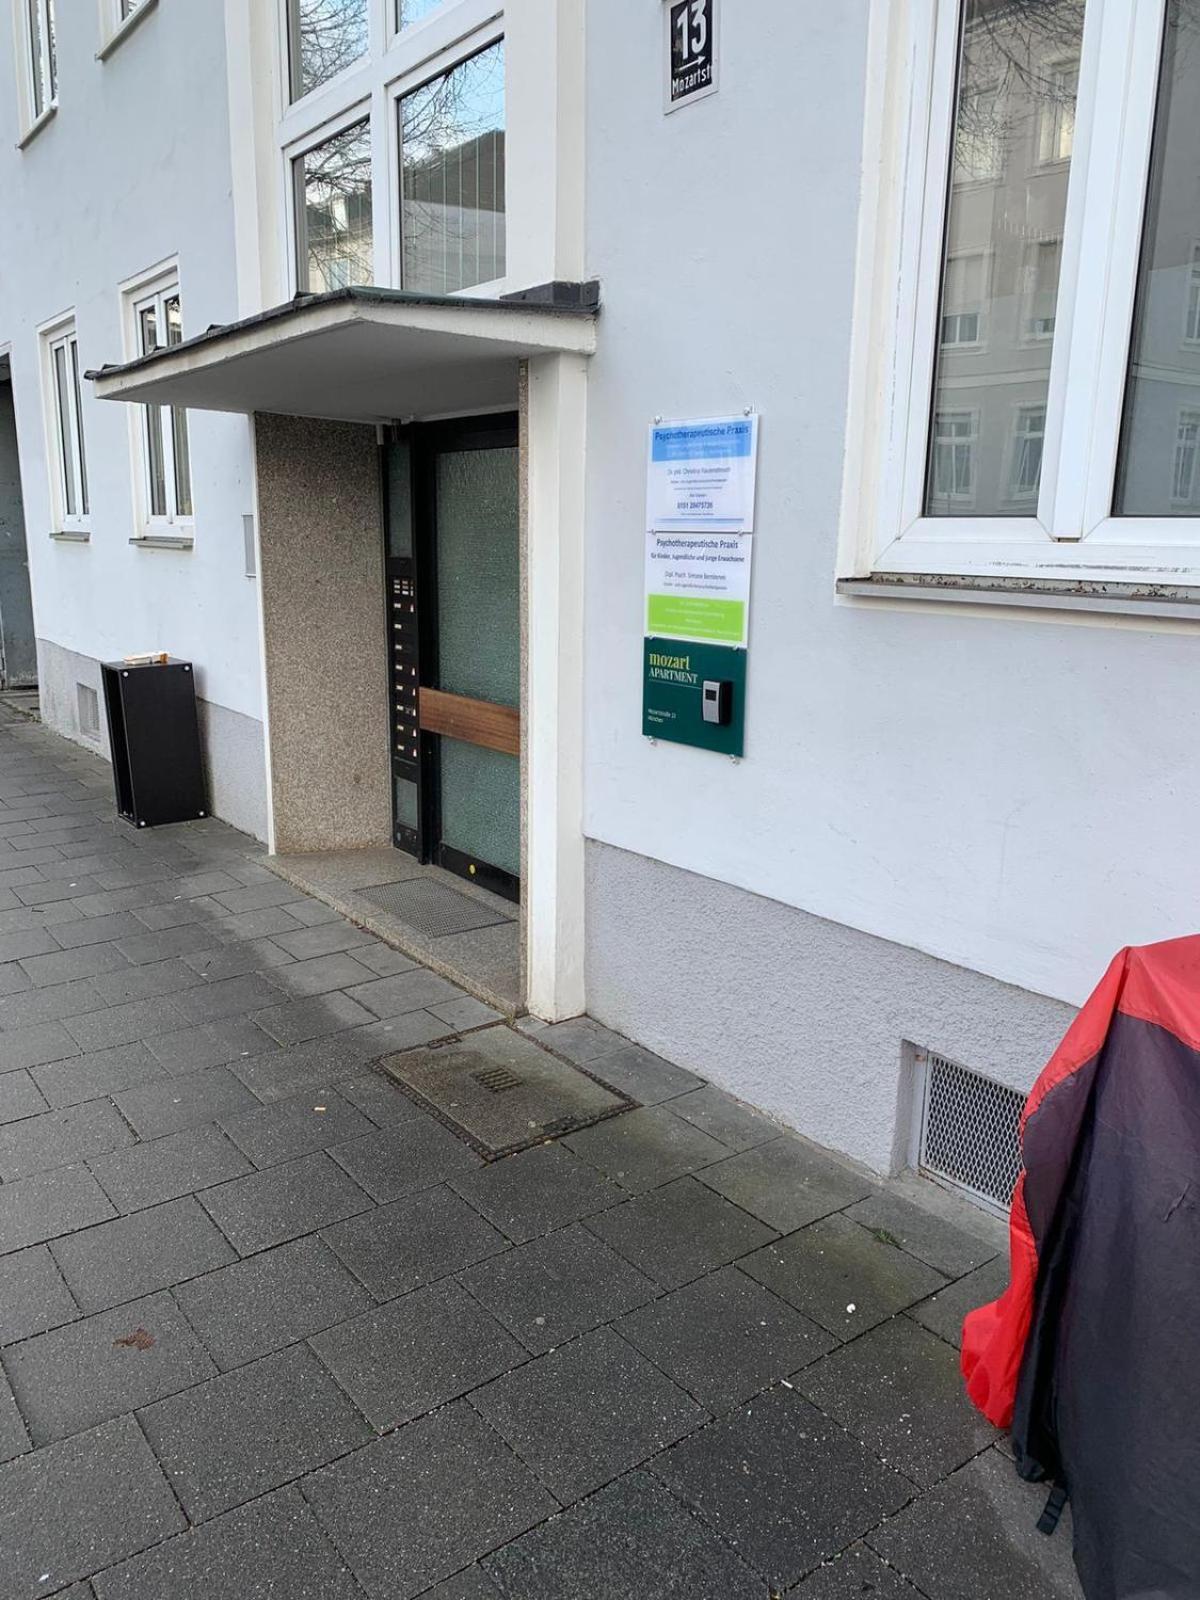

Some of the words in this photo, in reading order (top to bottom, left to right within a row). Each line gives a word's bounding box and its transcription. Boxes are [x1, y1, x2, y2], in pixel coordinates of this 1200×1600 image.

[676, 0, 706, 60] 13
[655, 428, 726, 442] Psychotherapeutische
[726, 425, 749, 434] Praxis
[656, 538, 718, 549] Psychotherapeutische
[719, 540, 738, 549] Praxis
[649, 653, 690, 670] mozart
[649, 667, 698, 683] APARTMENT
